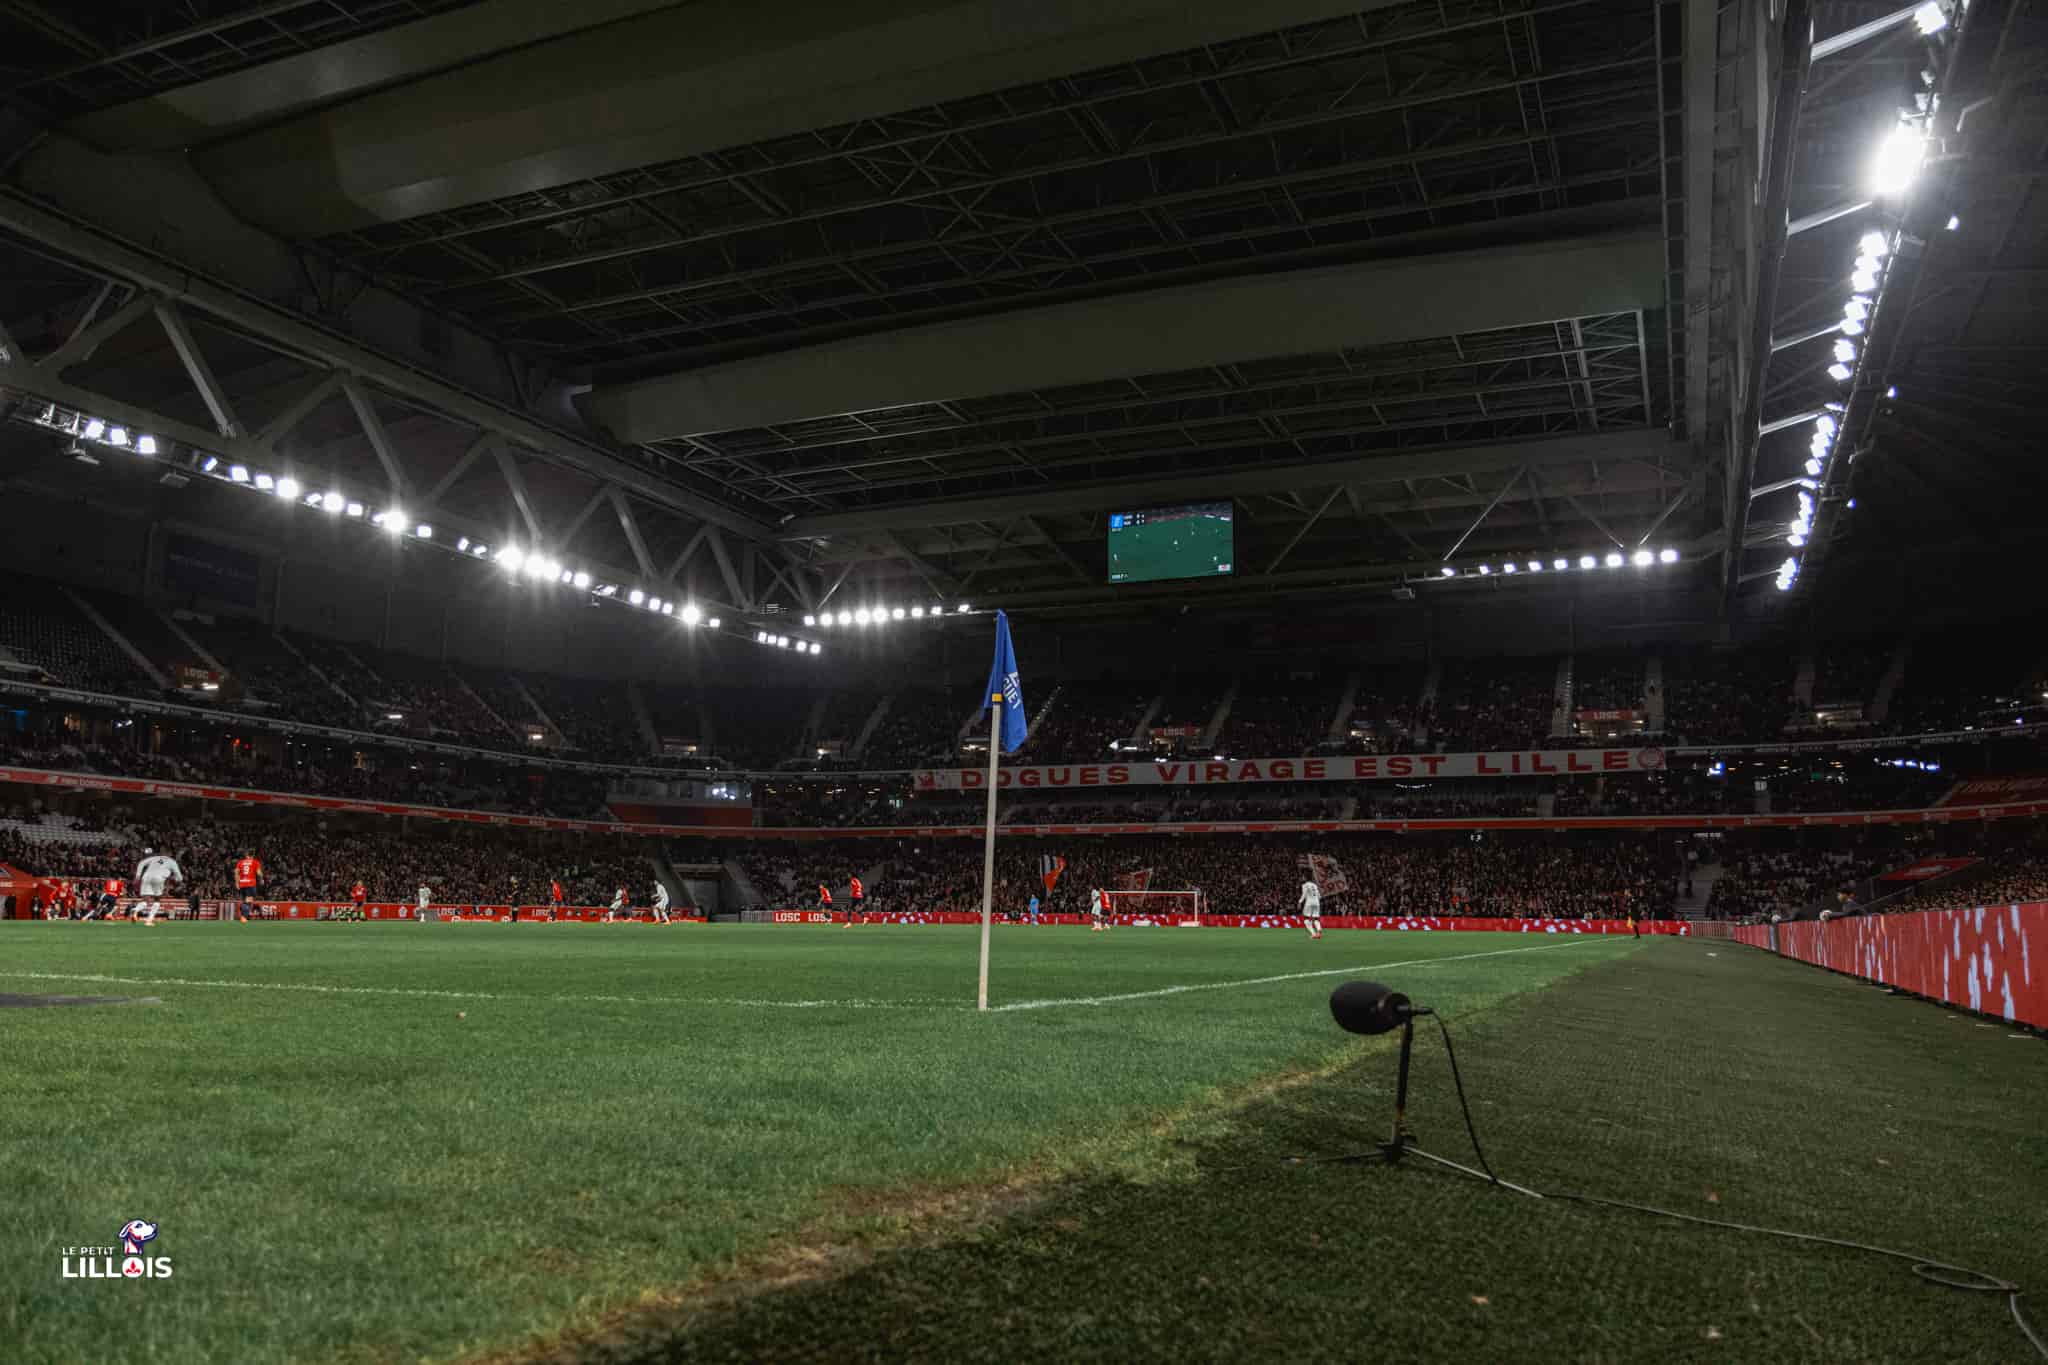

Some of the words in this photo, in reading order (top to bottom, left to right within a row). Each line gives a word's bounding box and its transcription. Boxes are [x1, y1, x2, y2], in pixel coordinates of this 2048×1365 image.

[961, 766, 1129, 788] DOGUES
[1156, 760, 1326, 783] VIRAGE
[1354, 756, 1446, 777] EST
[1477, 751, 1629, 775] LILLE
[775, 912, 800, 922] LOSC
